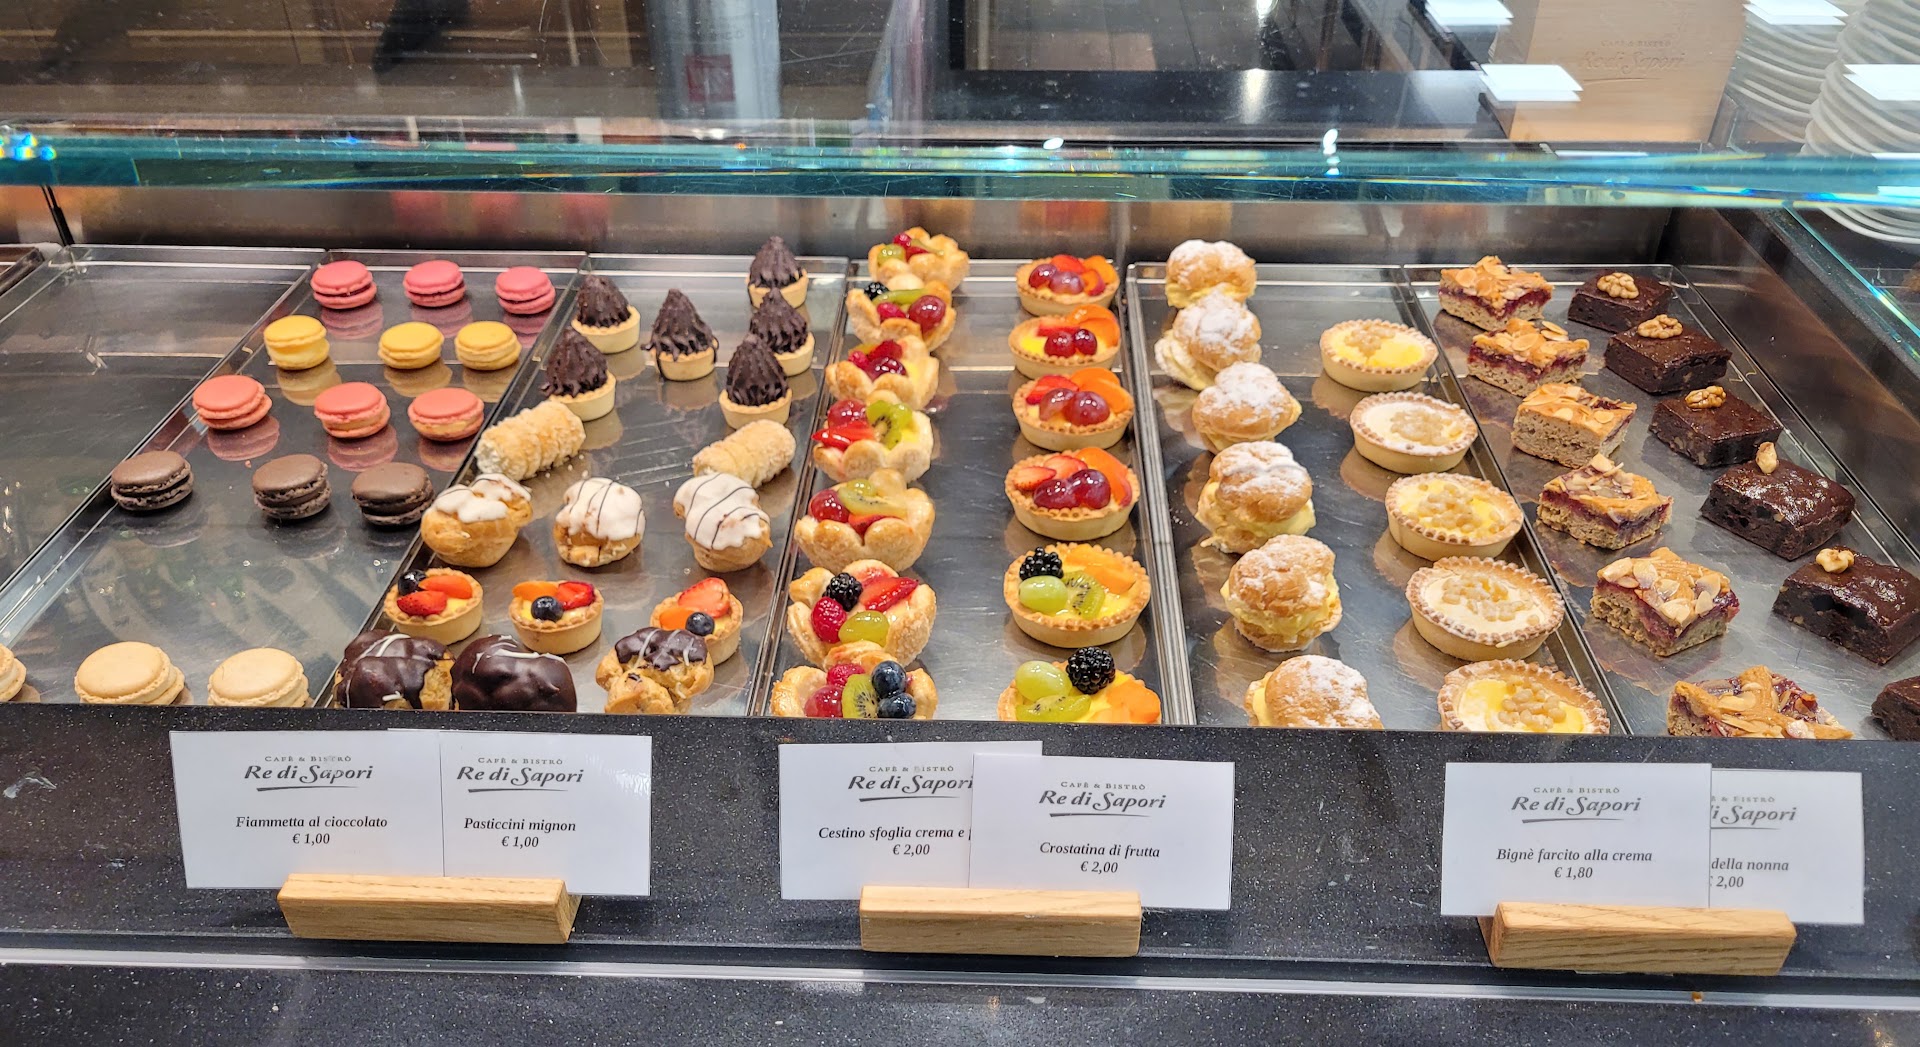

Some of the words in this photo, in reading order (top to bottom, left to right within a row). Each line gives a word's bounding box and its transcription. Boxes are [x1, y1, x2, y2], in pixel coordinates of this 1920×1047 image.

[244, 765, 273, 779] Re
[277, 765, 298, 779] di
[299, 764, 374, 784] Sapori
[456, 766, 485, 781] Re
[489, 766, 510, 781] di
[510, 766, 585, 787] Sapori
[848, 775, 876, 790] Re
[880, 775, 901, 789] di
[901, 775, 973, 794] Sapori
[1038, 790, 1068, 805] Re
[1071, 791, 1093, 806] di
[1092, 791, 1167, 812] Sapori
[1511, 796, 1540, 811] Re
[1544, 796, 1566, 811] di
[1565, 796, 1642, 816] Sapori
[235, 816, 305, 828] Fiammetta
[308, 815, 321, 828] al
[324, 815, 388, 828] cioccolato
[1711, 804, 1720, 820] i
[1720, 804, 1797, 826] Sapori
[463, 817, 526, 831] Pasticcini
[528, 819, 576, 834] mignon
[292, 833, 301, 845] €
[304, 833, 330, 846] 1,00
[818, 827, 866, 839] Cestino
[869, 826, 912, 842] sfoglia
[915, 829, 954, 838] crema
[958, 829, 965, 838] e
[501, 836, 510, 848] €
[513, 836, 539, 850] 1,00
[892, 844, 901, 856] €
[903, 844, 931, 858] 2,00
[1039, 841, 1106, 856] Crostatina
[1108, 844, 1122, 856] di
[1124, 844, 1161, 860] frutta
[1496, 848, 1534, 864] Bignè
[1537, 848, 1580, 864] farcito
[1584, 849, 1609, 861] alla
[1612, 852, 1653, 862] crema
[1711, 857, 1743, 870] della
[1746, 861, 1790, 871] nonna
[1080, 861, 1089, 872] €
[1091, 861, 1119, 875] 2,00
[1554, 866, 1563, 878] €
[1566, 866, 1594, 881] 1,80
[1716, 875, 1744, 889] 2,00
